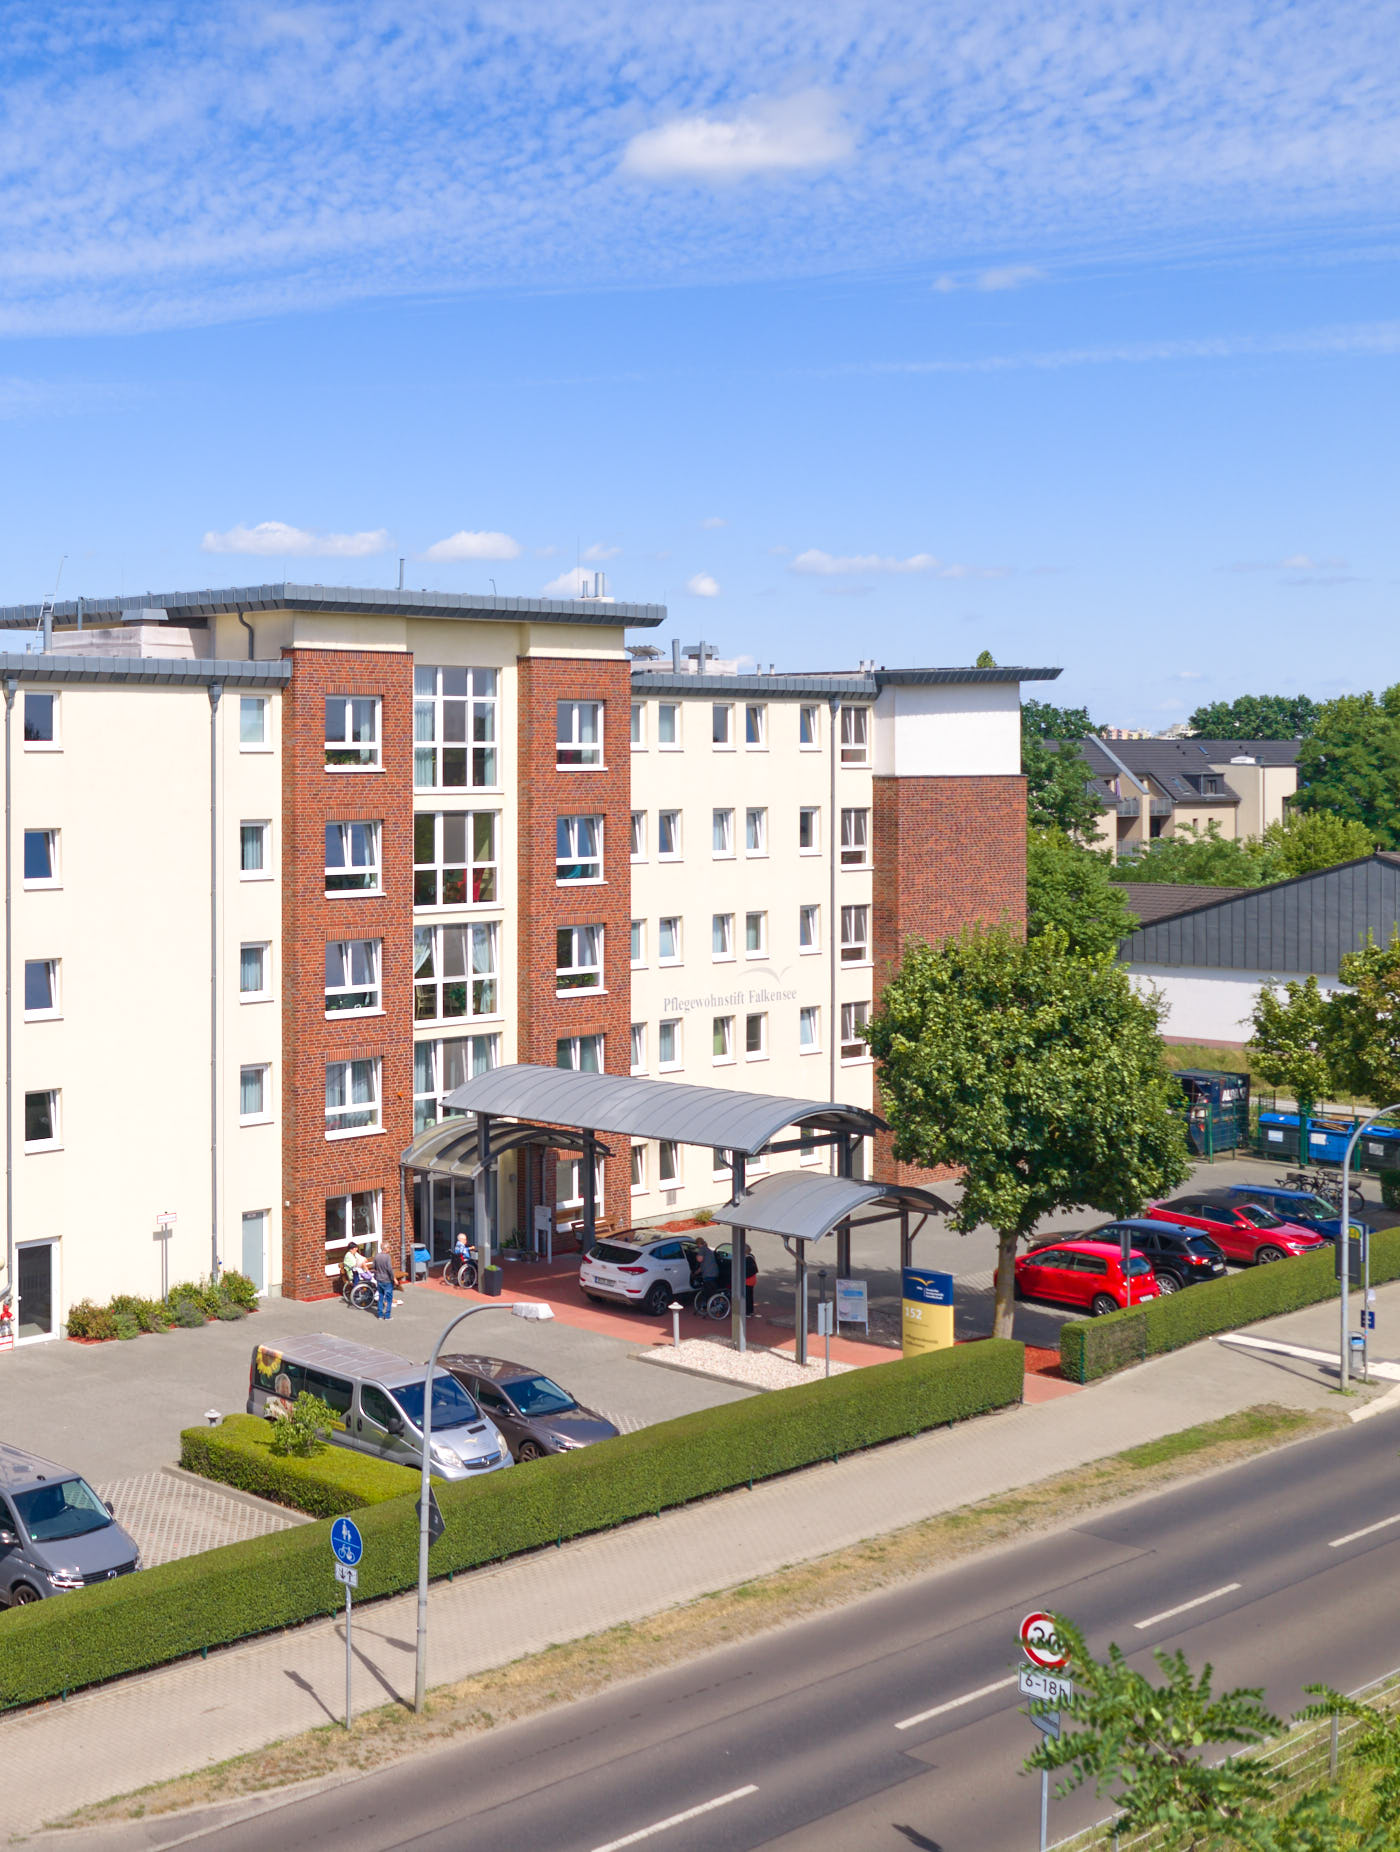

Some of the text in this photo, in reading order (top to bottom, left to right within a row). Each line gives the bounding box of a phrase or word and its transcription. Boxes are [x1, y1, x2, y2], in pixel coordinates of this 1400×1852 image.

[664, 988, 797, 1013] Pflegewohnstift Falkensee
[904, 1306, 922, 1320] 152
